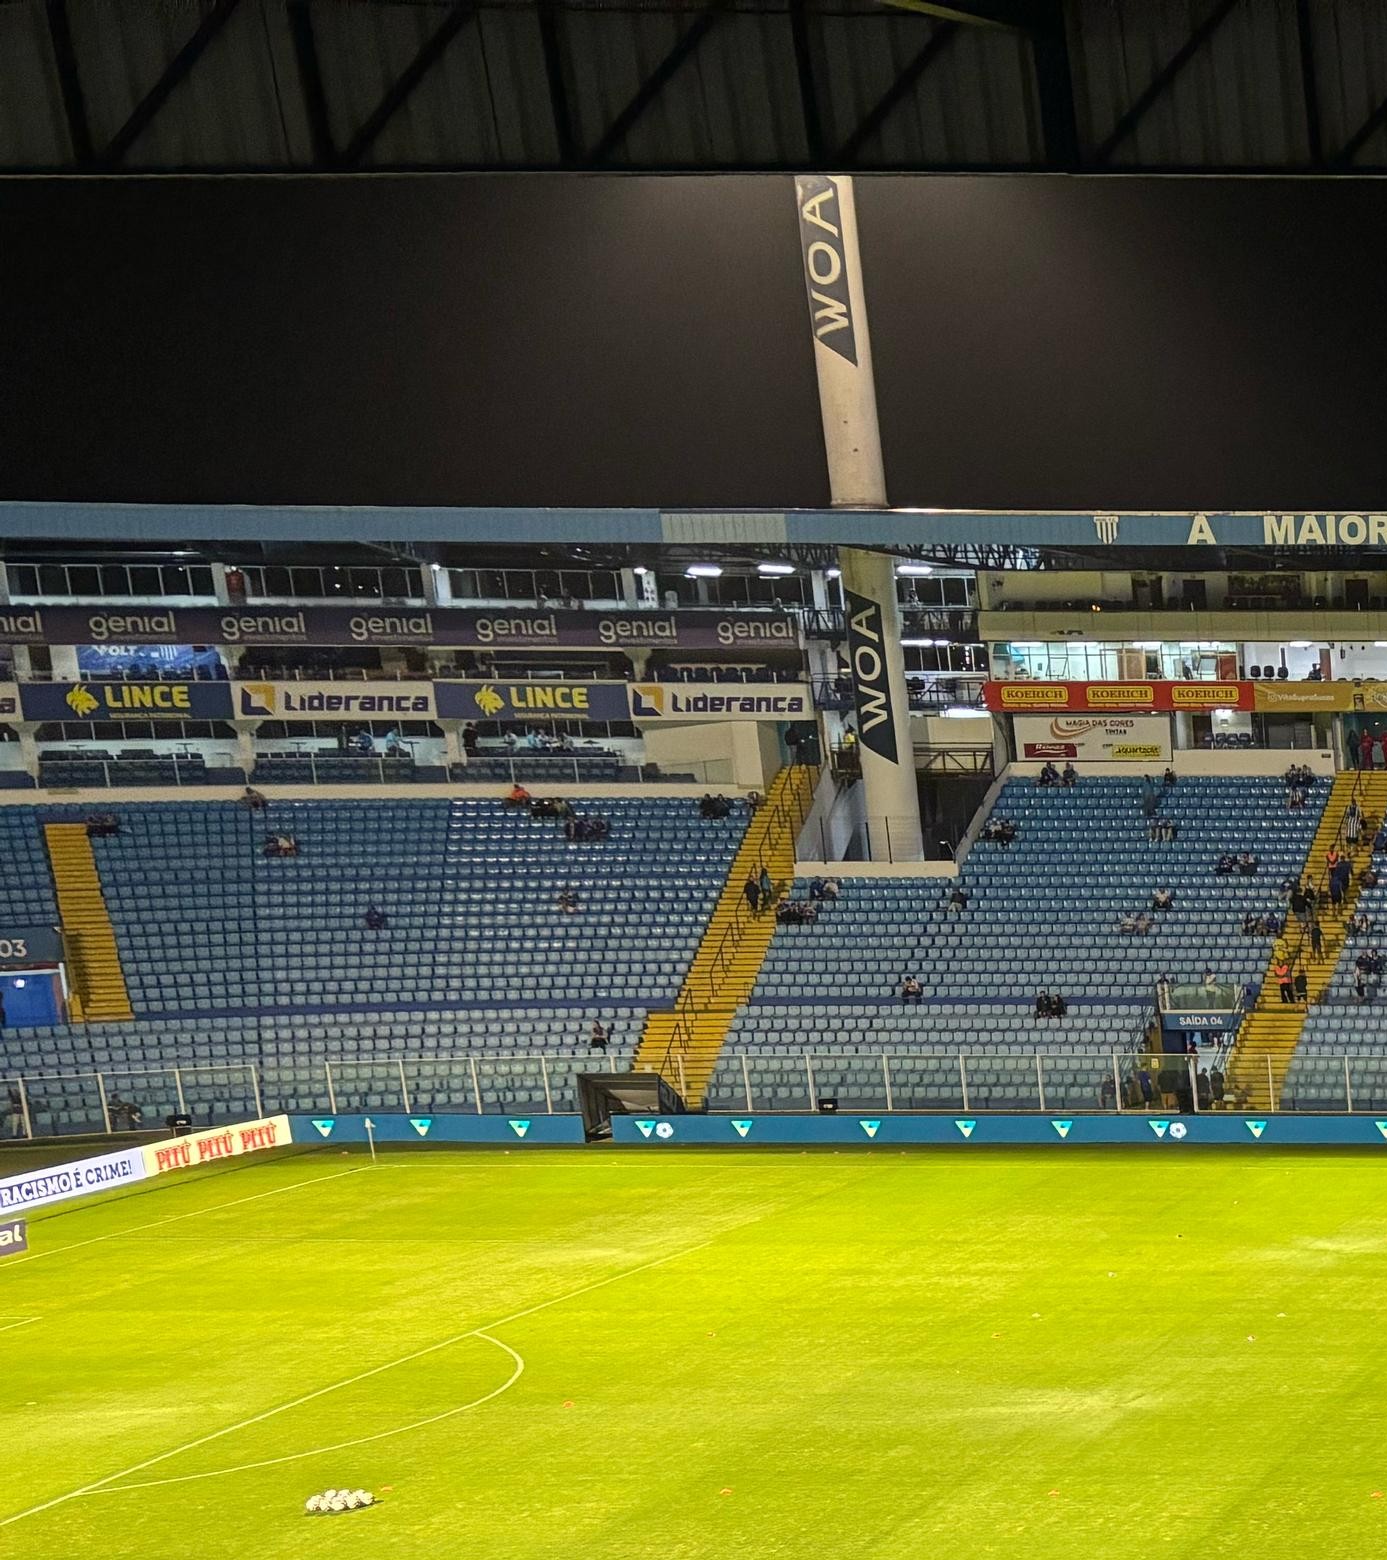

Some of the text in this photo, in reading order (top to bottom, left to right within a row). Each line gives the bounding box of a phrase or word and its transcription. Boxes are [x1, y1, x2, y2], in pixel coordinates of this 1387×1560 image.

[802, 187, 849, 338] WOA
[1187, 514, 1217, 545] A
[89, 611, 175, 641] genial
[221, 611, 306, 641] genial
[349, 613, 433, 642] genial
[476, 614, 557, 643] genial
[599, 615, 677, 644] genial
[717, 616, 793, 645] genial
[850, 605, 888, 734] WOA
[104, 684, 191, 708] LINCE
[510, 685, 590, 709] LINCE
[1179, 1014, 1223, 1026] SAÍDA 04
[1, 1160, 134, 1207] RACISMO É CRIME!
